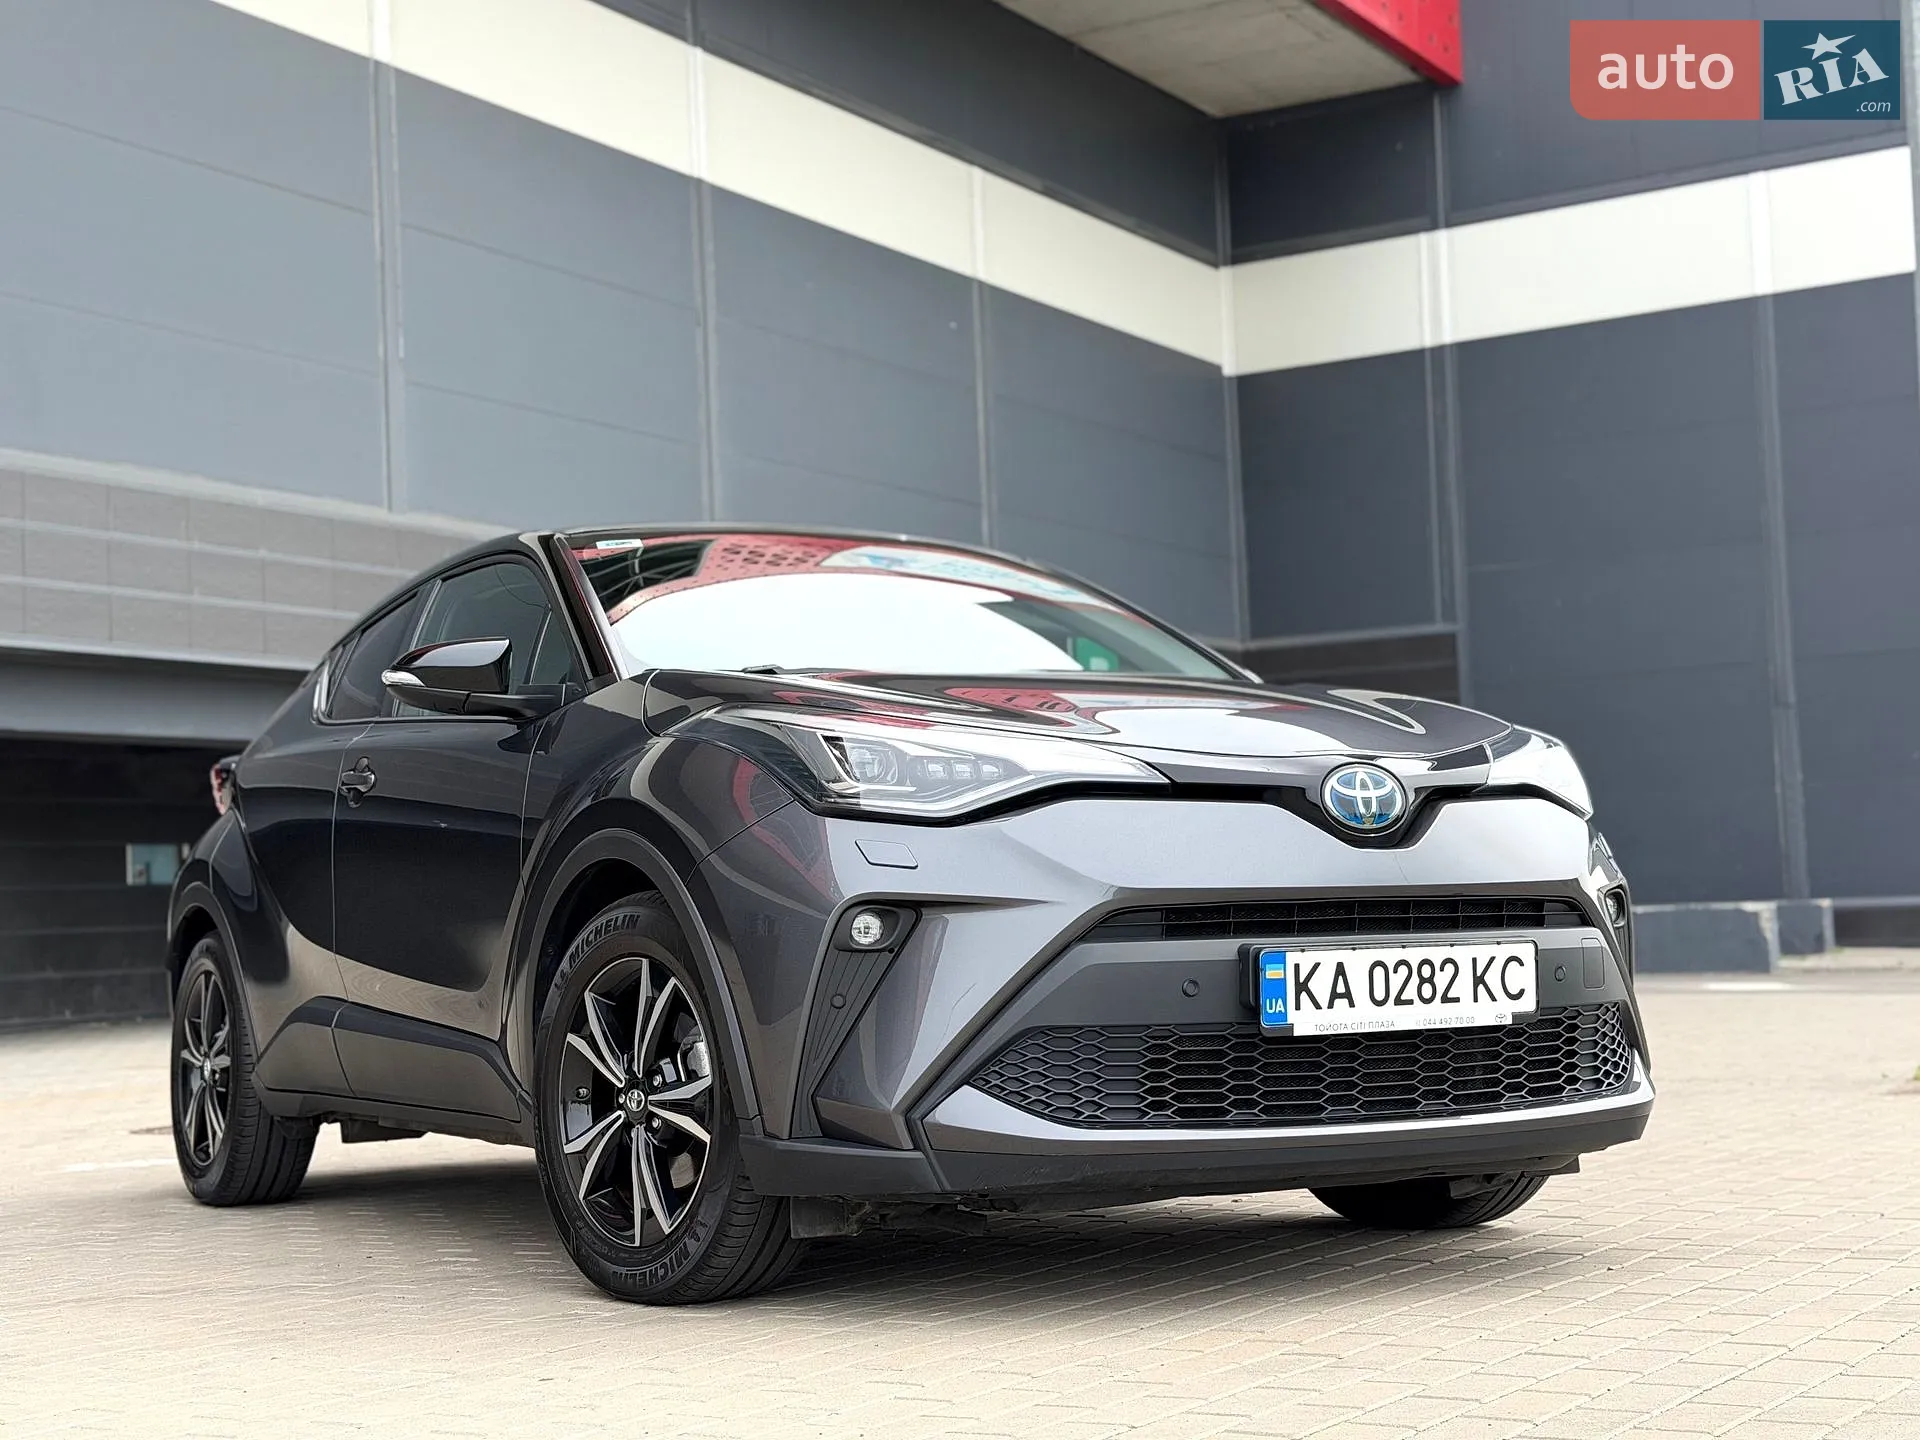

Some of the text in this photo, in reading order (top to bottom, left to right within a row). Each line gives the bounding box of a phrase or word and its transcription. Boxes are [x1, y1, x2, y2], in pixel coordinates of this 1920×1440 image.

[568, 912, 641, 970] MICHELIN
[1266, 998, 1285, 1014] UA
[1294, 955, 1525, 1011] KA 0282 KC
